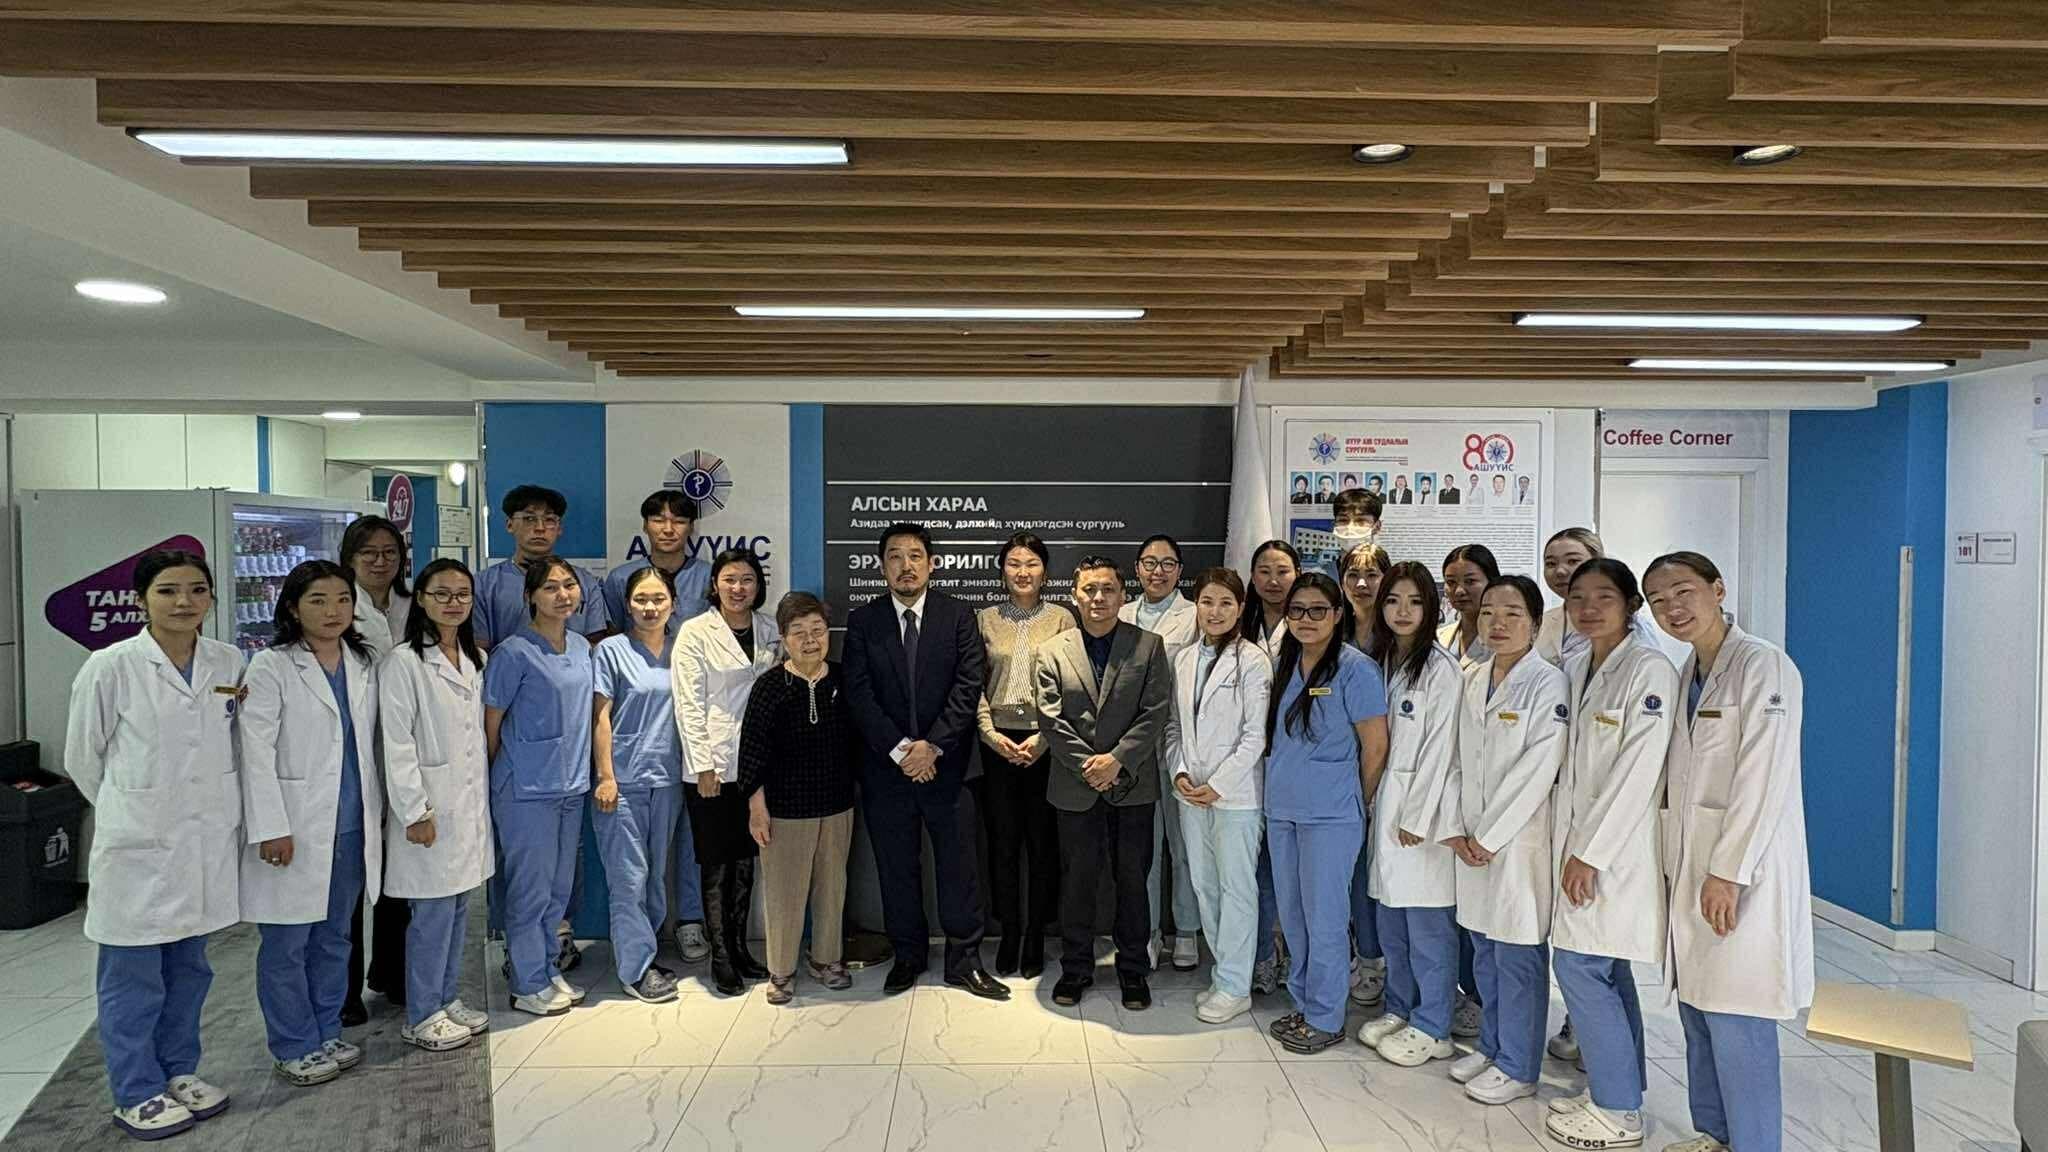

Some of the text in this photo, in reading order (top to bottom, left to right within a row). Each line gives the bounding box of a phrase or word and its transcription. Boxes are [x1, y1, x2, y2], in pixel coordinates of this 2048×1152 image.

[1603, 429, 1734, 445] Coffee Corner
[851, 496, 988, 512] АЛСЫН ХАРАА
[850, 518, 890, 529] Азидаа
[955, 518, 1003, 529] дэлхийд
[1005, 519, 1074, 530] хүндлэгдсэн
[626, 535, 771, 561] АУҮИС
[88, 611, 109, 632] 5
[1566, 1135, 1607, 1148] crocs
